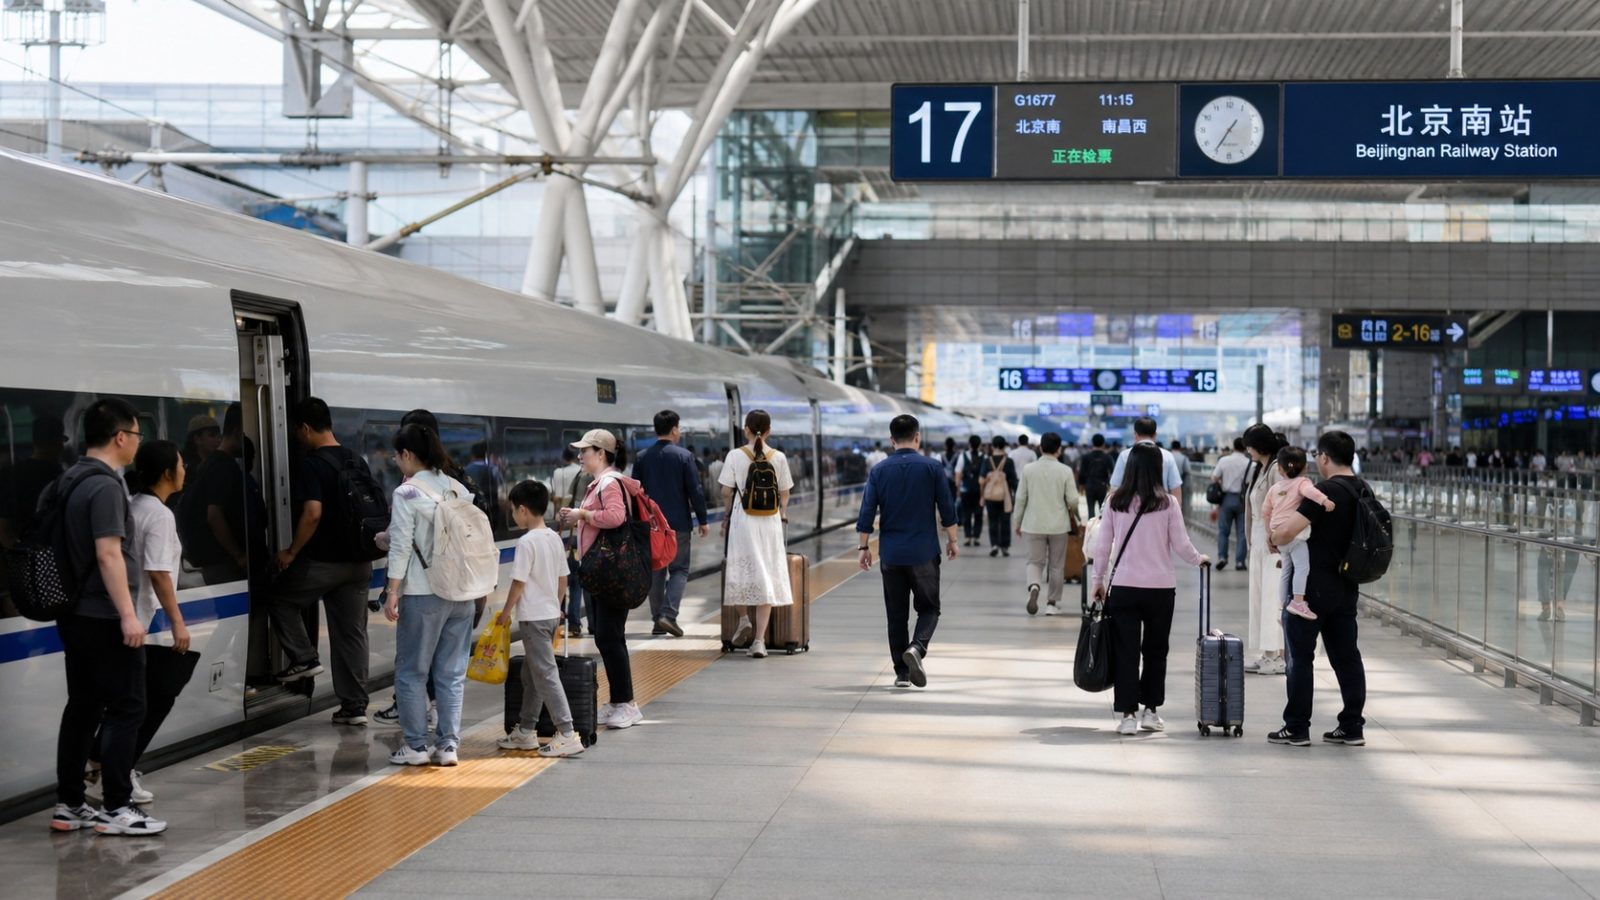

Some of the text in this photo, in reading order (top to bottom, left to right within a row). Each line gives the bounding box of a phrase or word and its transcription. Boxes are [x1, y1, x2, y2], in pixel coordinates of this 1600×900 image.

[1014, 93, 1057, 107] G1677
[1099, 93, 1134, 107] 11:15
[1015, 118, 1061, 135] 北京南
[1101, 118, 1147, 135] 南昌西
[1380, 103, 1533, 137] 北京南站
[908, 100, 982, 164] 17
[1051, 147, 1113, 165] 正在检票
[1356, 143, 1559, 161] Beijingnan Railway Station
[1392, 323, 1431, 342] 2-16
[1000, 369, 1023, 390] 16
[1194, 371, 1217, 392] 15
